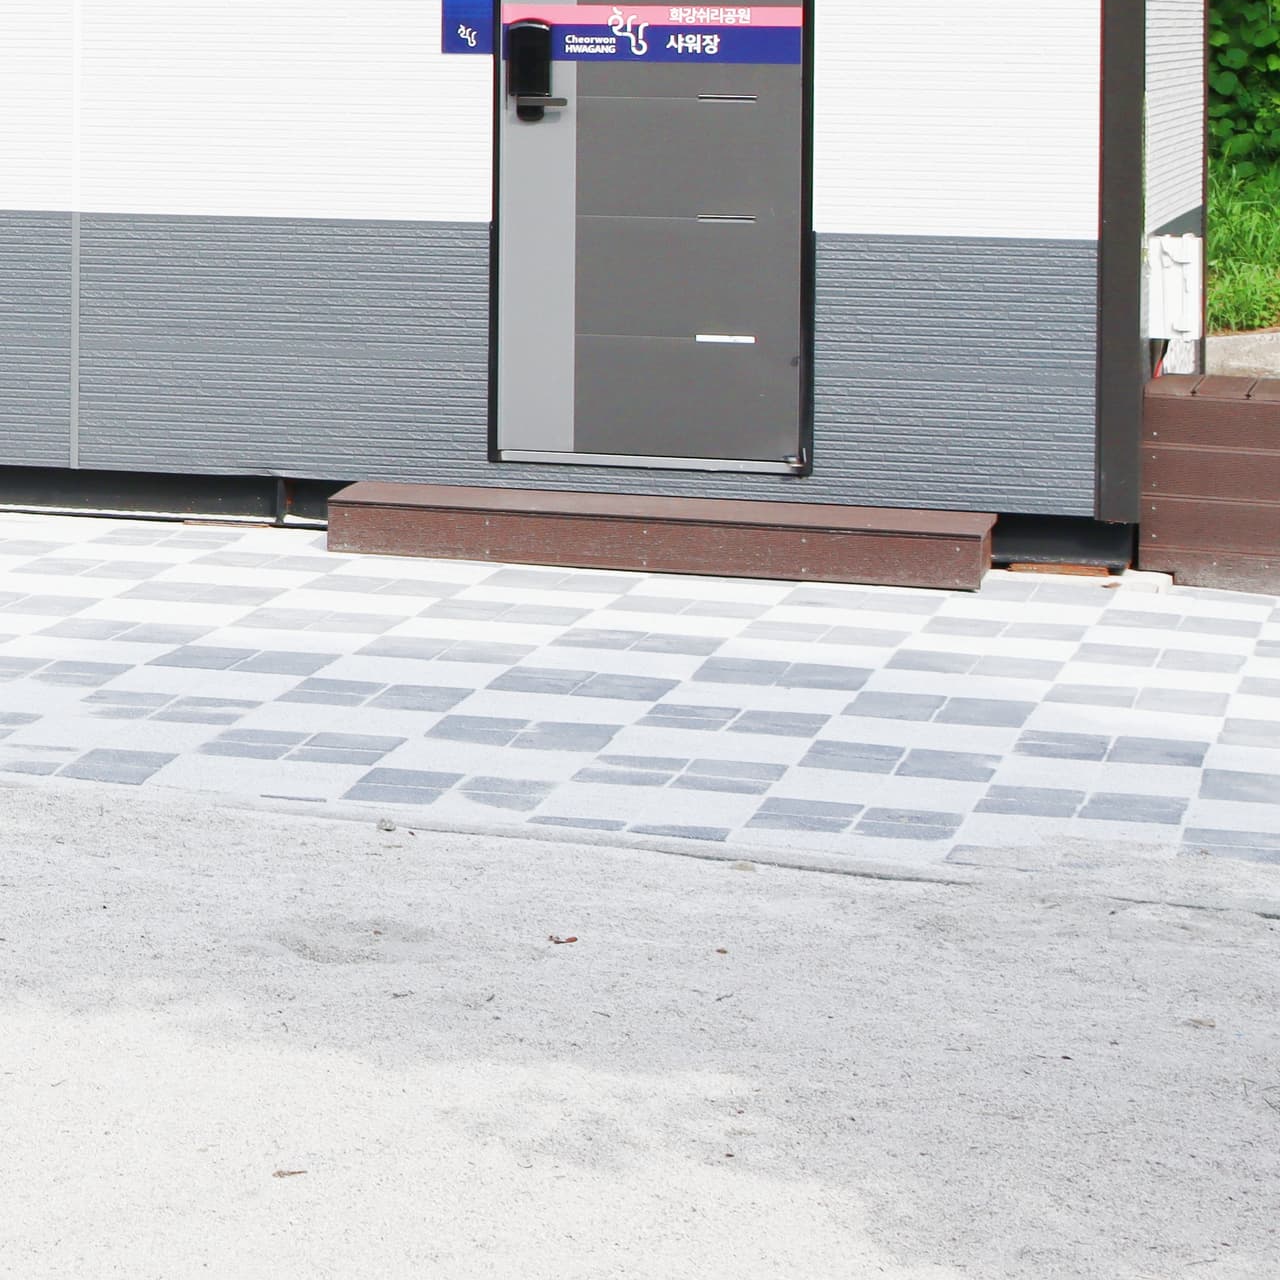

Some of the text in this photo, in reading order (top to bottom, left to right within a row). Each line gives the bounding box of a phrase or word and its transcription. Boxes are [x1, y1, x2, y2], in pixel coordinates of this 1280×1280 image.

[668, 7, 751, 24] 화강쉬리공원
[565, 34, 616, 44] Cheorwon
[665, 33, 721, 55] 샤워장
[565, 44, 616, 54] HWAGANG
